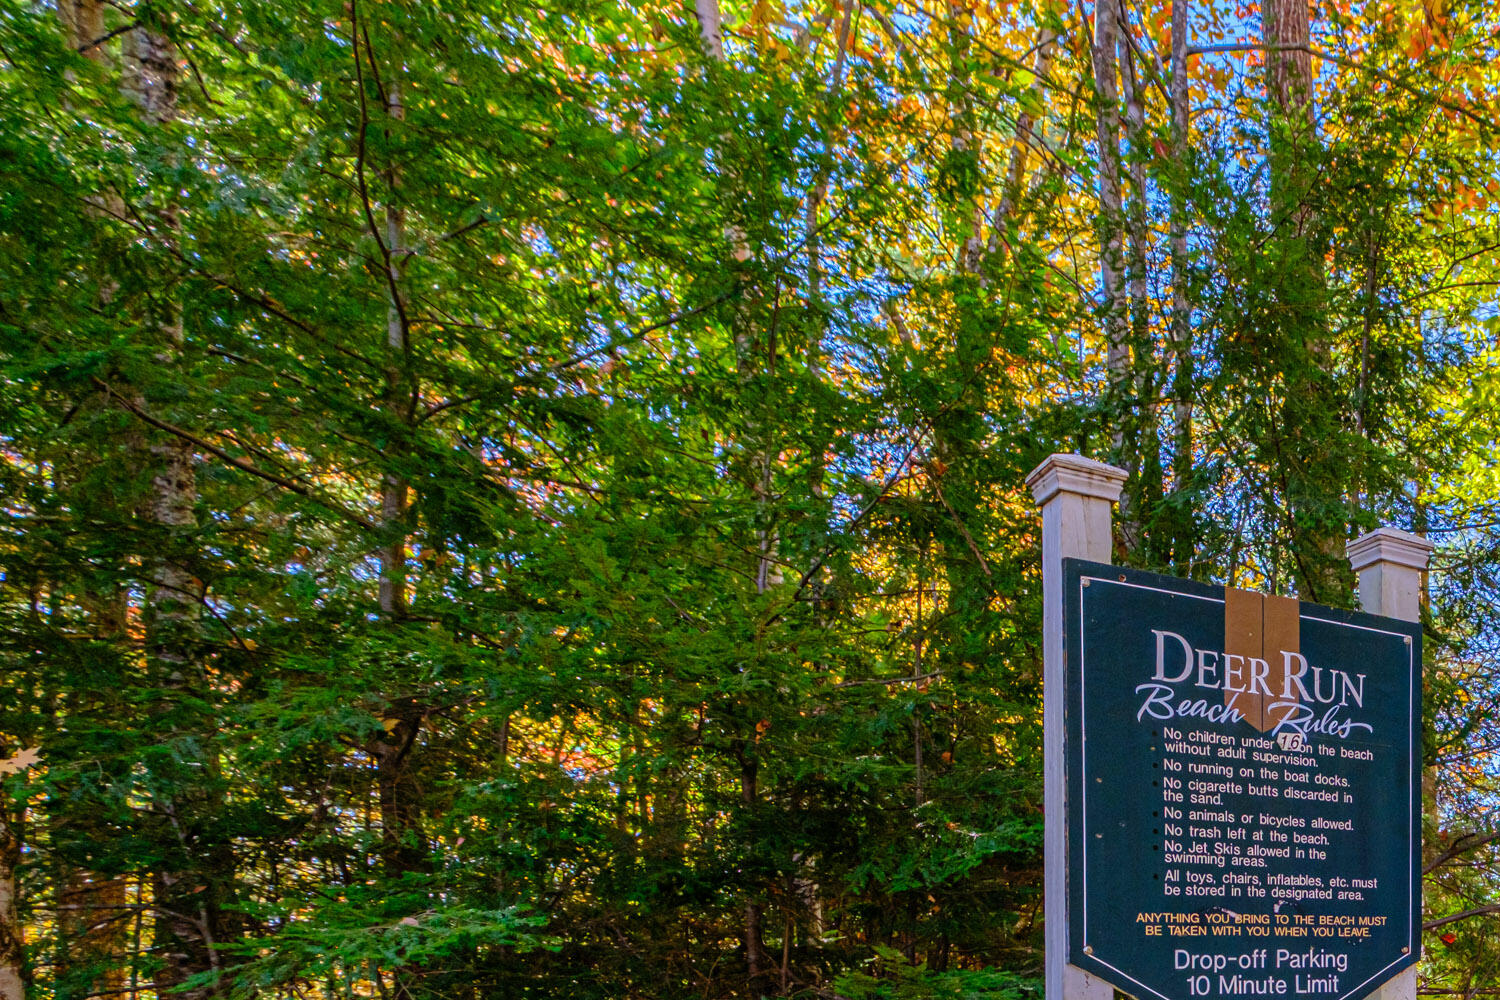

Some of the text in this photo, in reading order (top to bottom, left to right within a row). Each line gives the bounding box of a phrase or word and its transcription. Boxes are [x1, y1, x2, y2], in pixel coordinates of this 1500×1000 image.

[1151, 629, 1367, 708] DEER RUN
[1135, 683, 1373, 744] Beach Rules
[1163, 727, 1374, 761] No children under 16 on the beach
[1165, 742, 1319, 768] without adult supervision.
[1163, 758, 1350, 788] No running on the boat docks.
[1163, 776, 1353, 804] No cigarette butts discarded in
[1163, 790, 1224, 806] the sand.
[1163, 806, 1354, 831] No animals or bicycles allowed.
[1164, 823, 1330, 846] No trash left at the beach.
[1164, 840, 1327, 860] No Jet Skis allowed in the
[1164, 852, 1268, 868] swimming areas.
[1164, 869, 1378, 889] All toys, chairs, inflatables, etc. must
[1164, 883, 1365, 901] be stored in the designated area.
[1136, 912, 1387, 926] ANYTHING YOU BRING TO THE BEACH MUST
[1145, 925, 1372, 937] BE TAKEN WITH YOU WHEN YOU LEAVE.
[1174, 948, 1348, 973] Drop-off Parking
[1186, 973, 1339, 996] 10 Minute Limit
